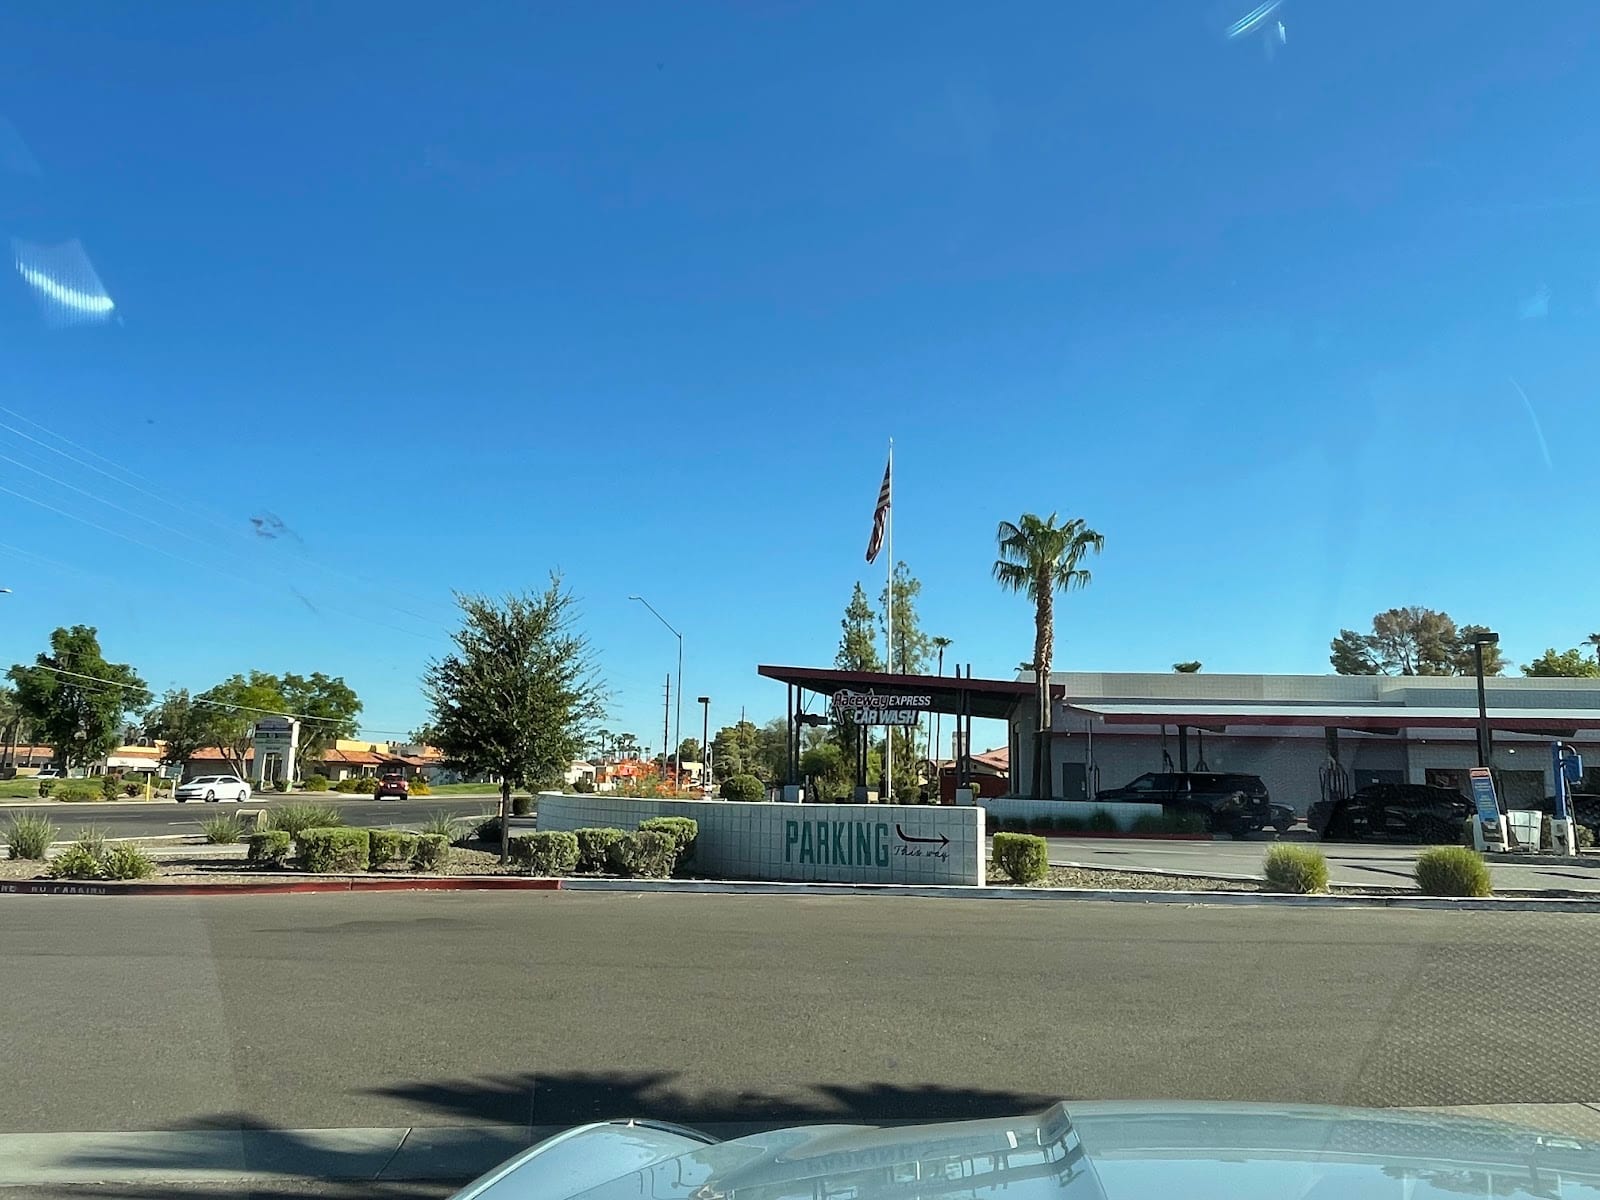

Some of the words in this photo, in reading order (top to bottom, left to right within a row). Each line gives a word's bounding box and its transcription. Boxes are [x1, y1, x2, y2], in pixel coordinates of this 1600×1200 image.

[833, 691, 889, 709] Raceway
[888, 695, 931, 706] EXPRESS
[854, 709, 878, 724] CAR
[879, 709, 917, 724] WASH
[785, 820, 889, 867] PARKING
[894, 845, 921, 857] This
[926, 850, 950, 863] way
